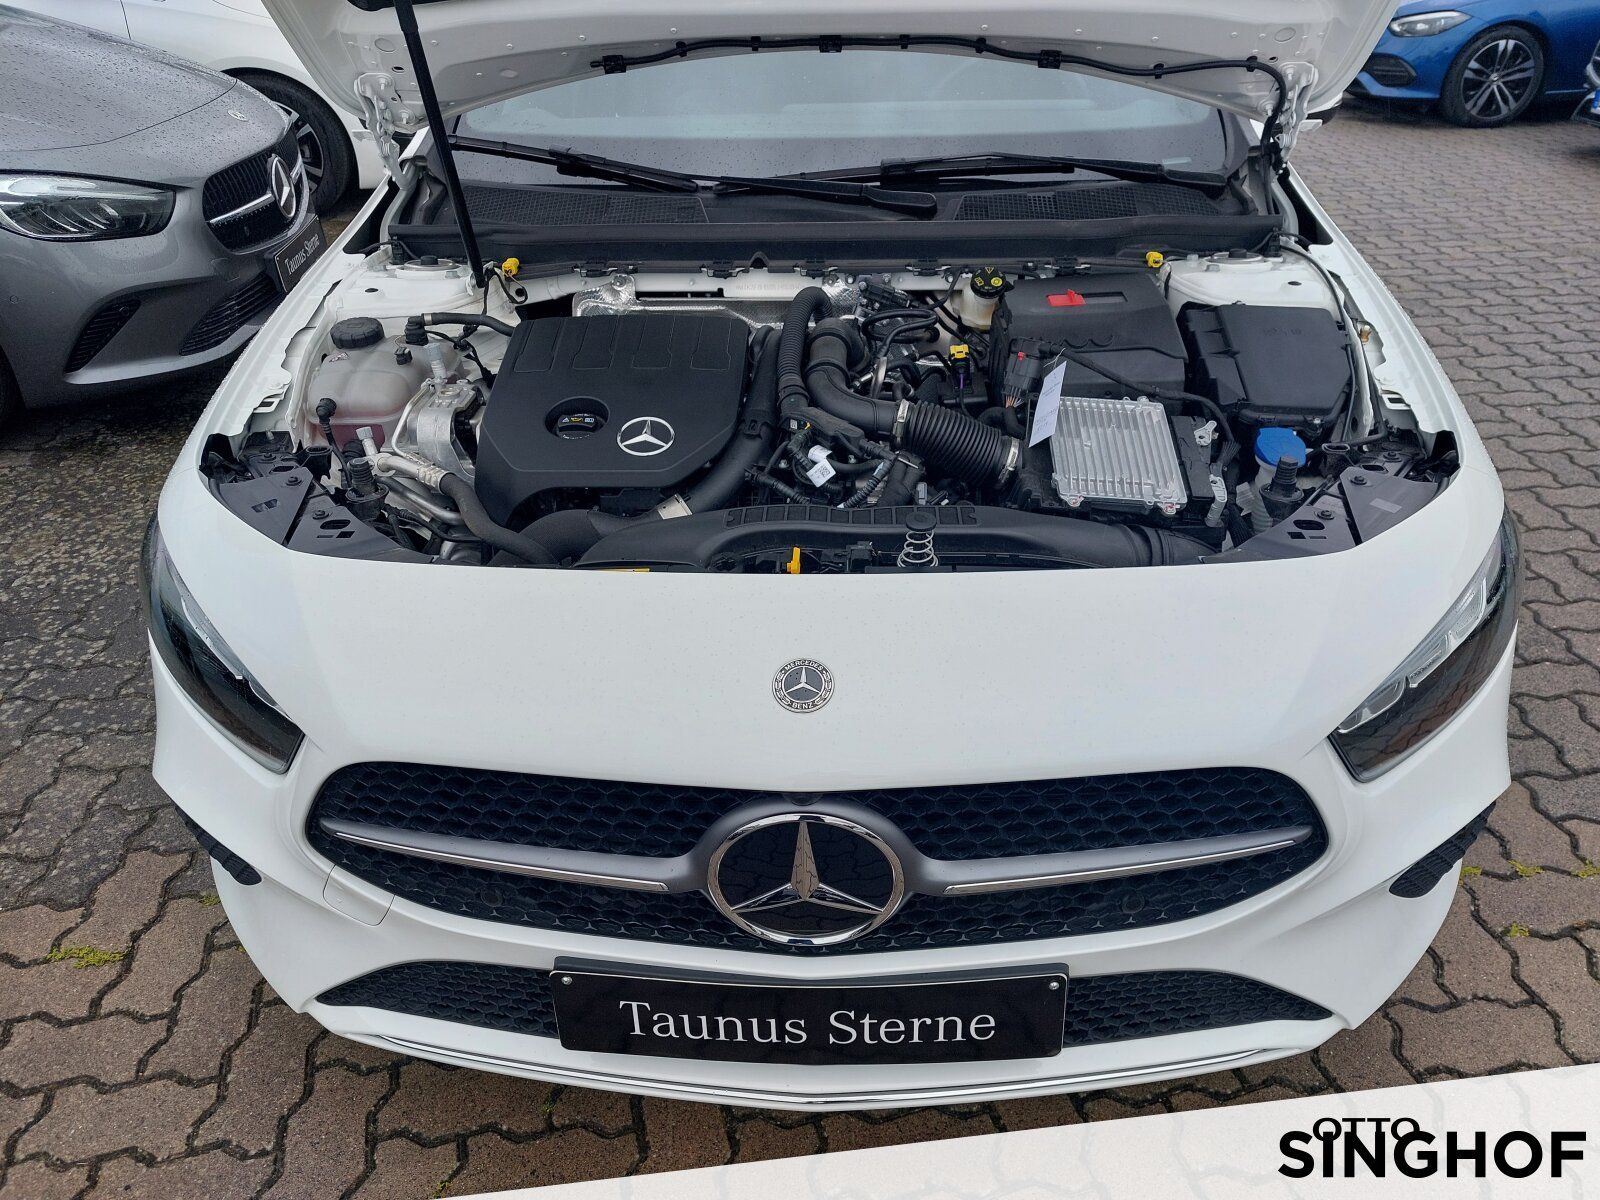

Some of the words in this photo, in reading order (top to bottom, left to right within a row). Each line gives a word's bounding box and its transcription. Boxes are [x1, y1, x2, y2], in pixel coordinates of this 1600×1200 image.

[284, 248, 307, 275] Taunus
[784, 660, 824, 671] MERCEDES
[619, 1001, 808, 1045] Taunus
[829, 1010, 996, 1045] Sterne
